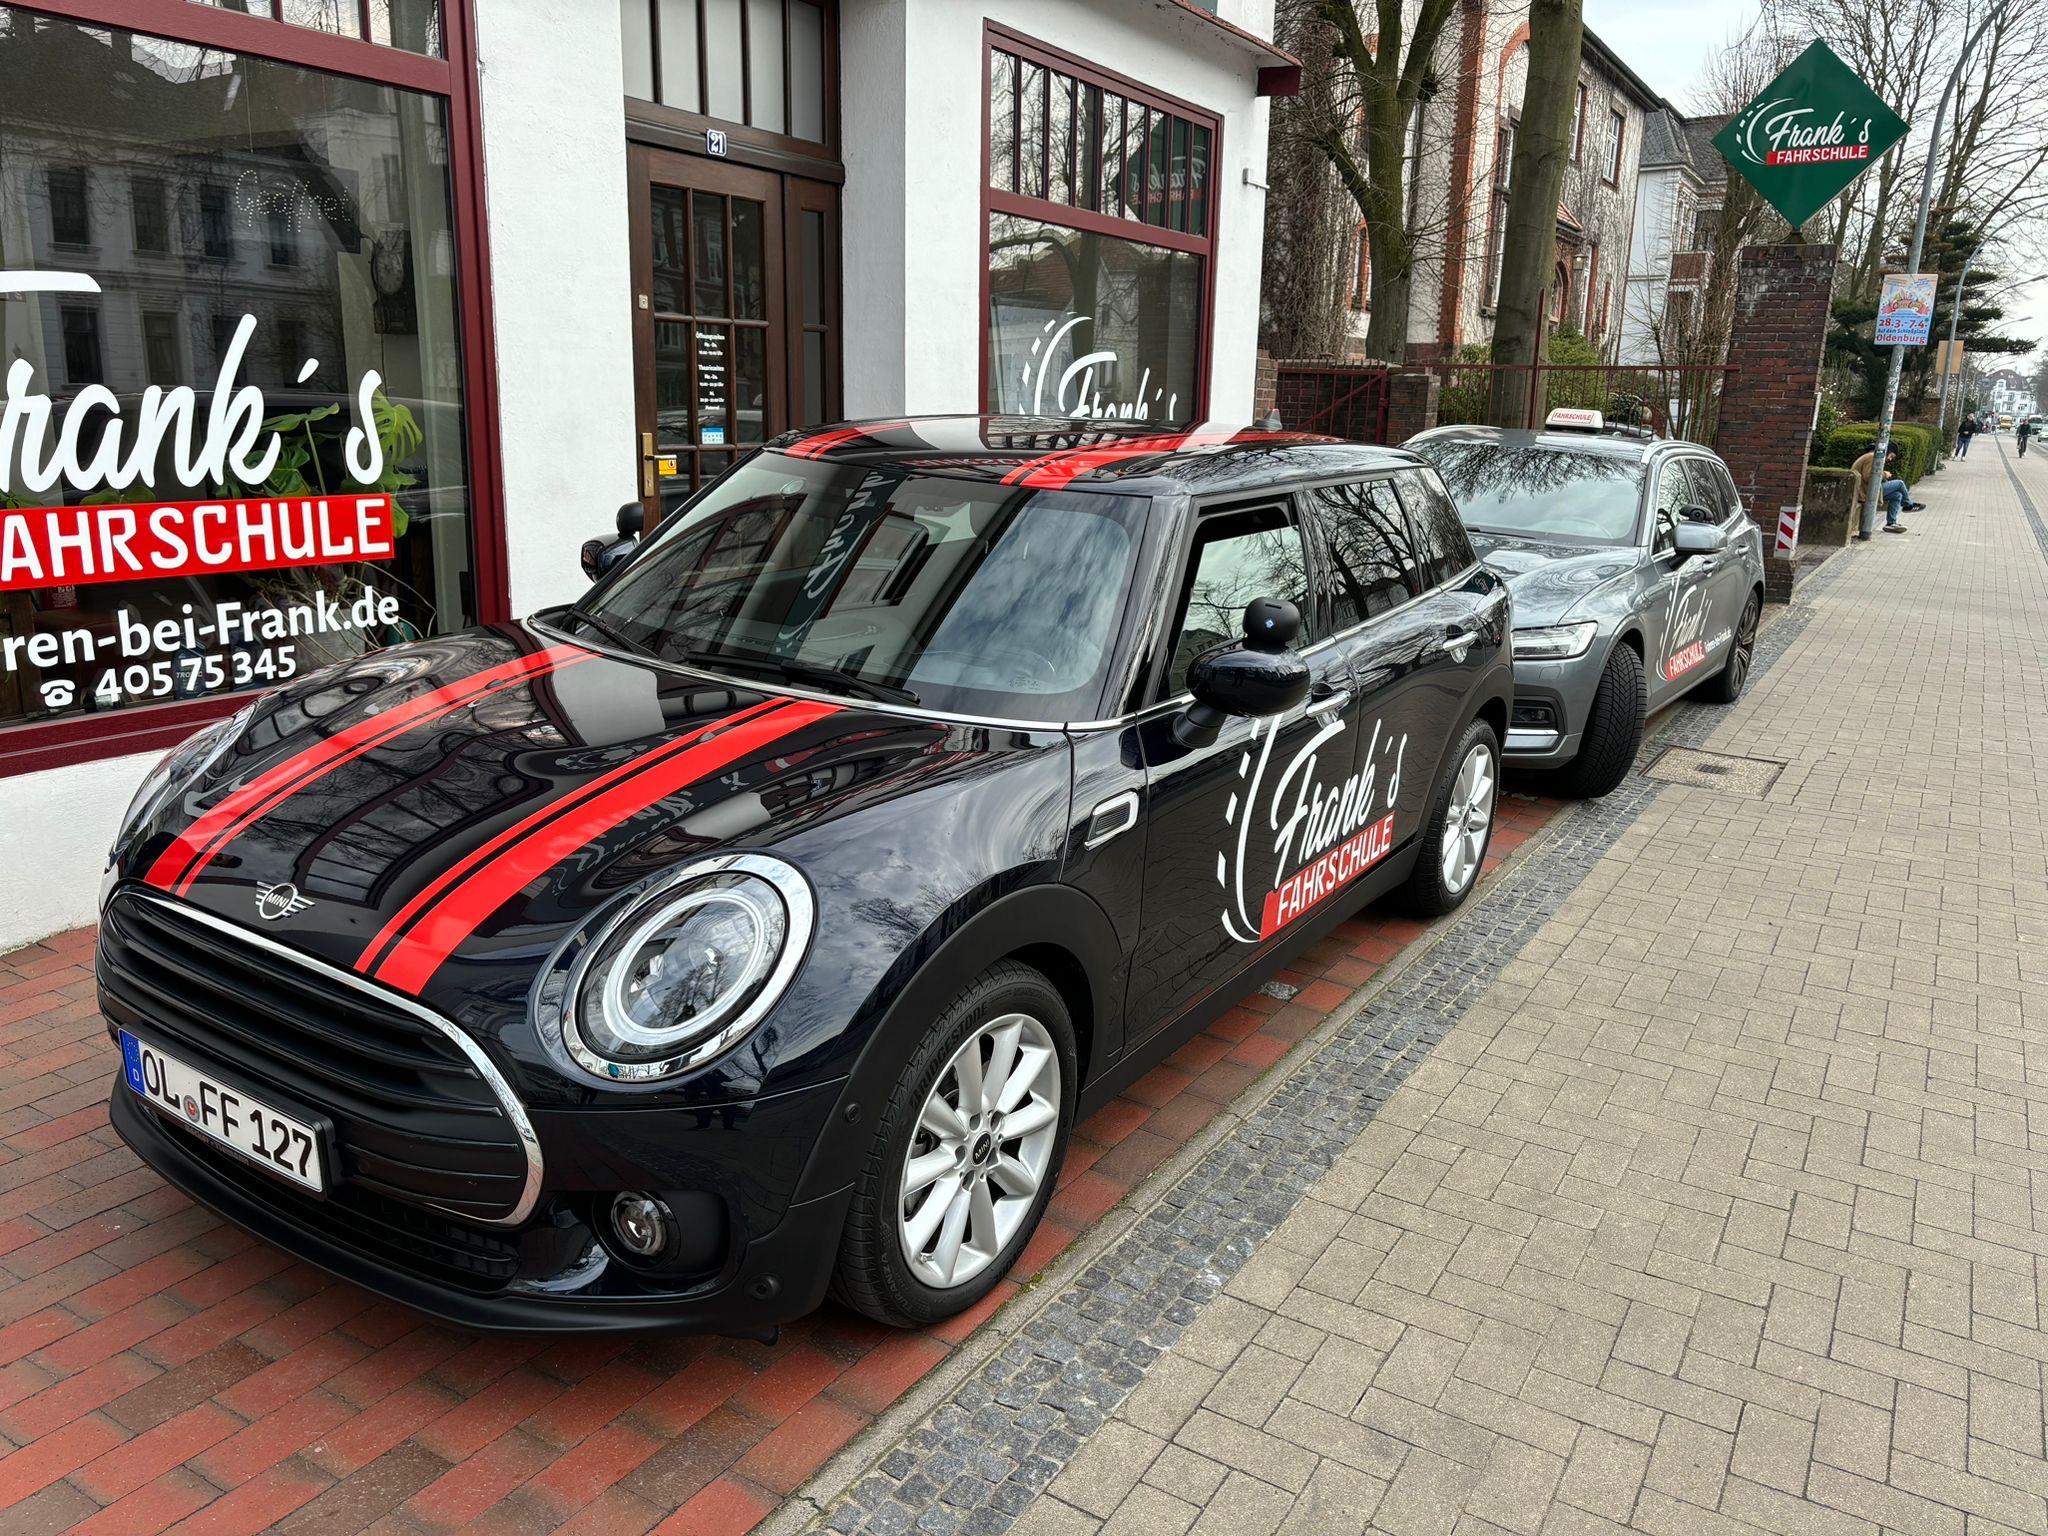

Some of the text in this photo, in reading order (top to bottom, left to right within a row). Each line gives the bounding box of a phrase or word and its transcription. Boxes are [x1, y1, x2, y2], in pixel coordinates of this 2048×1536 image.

[710, 132, 724, 154] 21
[1776, 145, 1869, 164] FAHRSCHULE
[1876, 333, 1926, 345] Oldenburg
[1553, 412, 1592, 421] FAHRSCHULE
[1669, 640, 1705, 677] FAHRSCHULE
[95, 645, 297, 703] 405 75 345
[1277, 814, 1394, 926] FAHRSCHULE
[265, 893, 290, 909] MINI
[132, 1068, 140, 1082] D
[142, 1049, 181, 1110] OL
[200, 1080, 240, 1138] FF
[250, 1109, 312, 1178] 127
[975, 1138, 990, 1160] MINI
